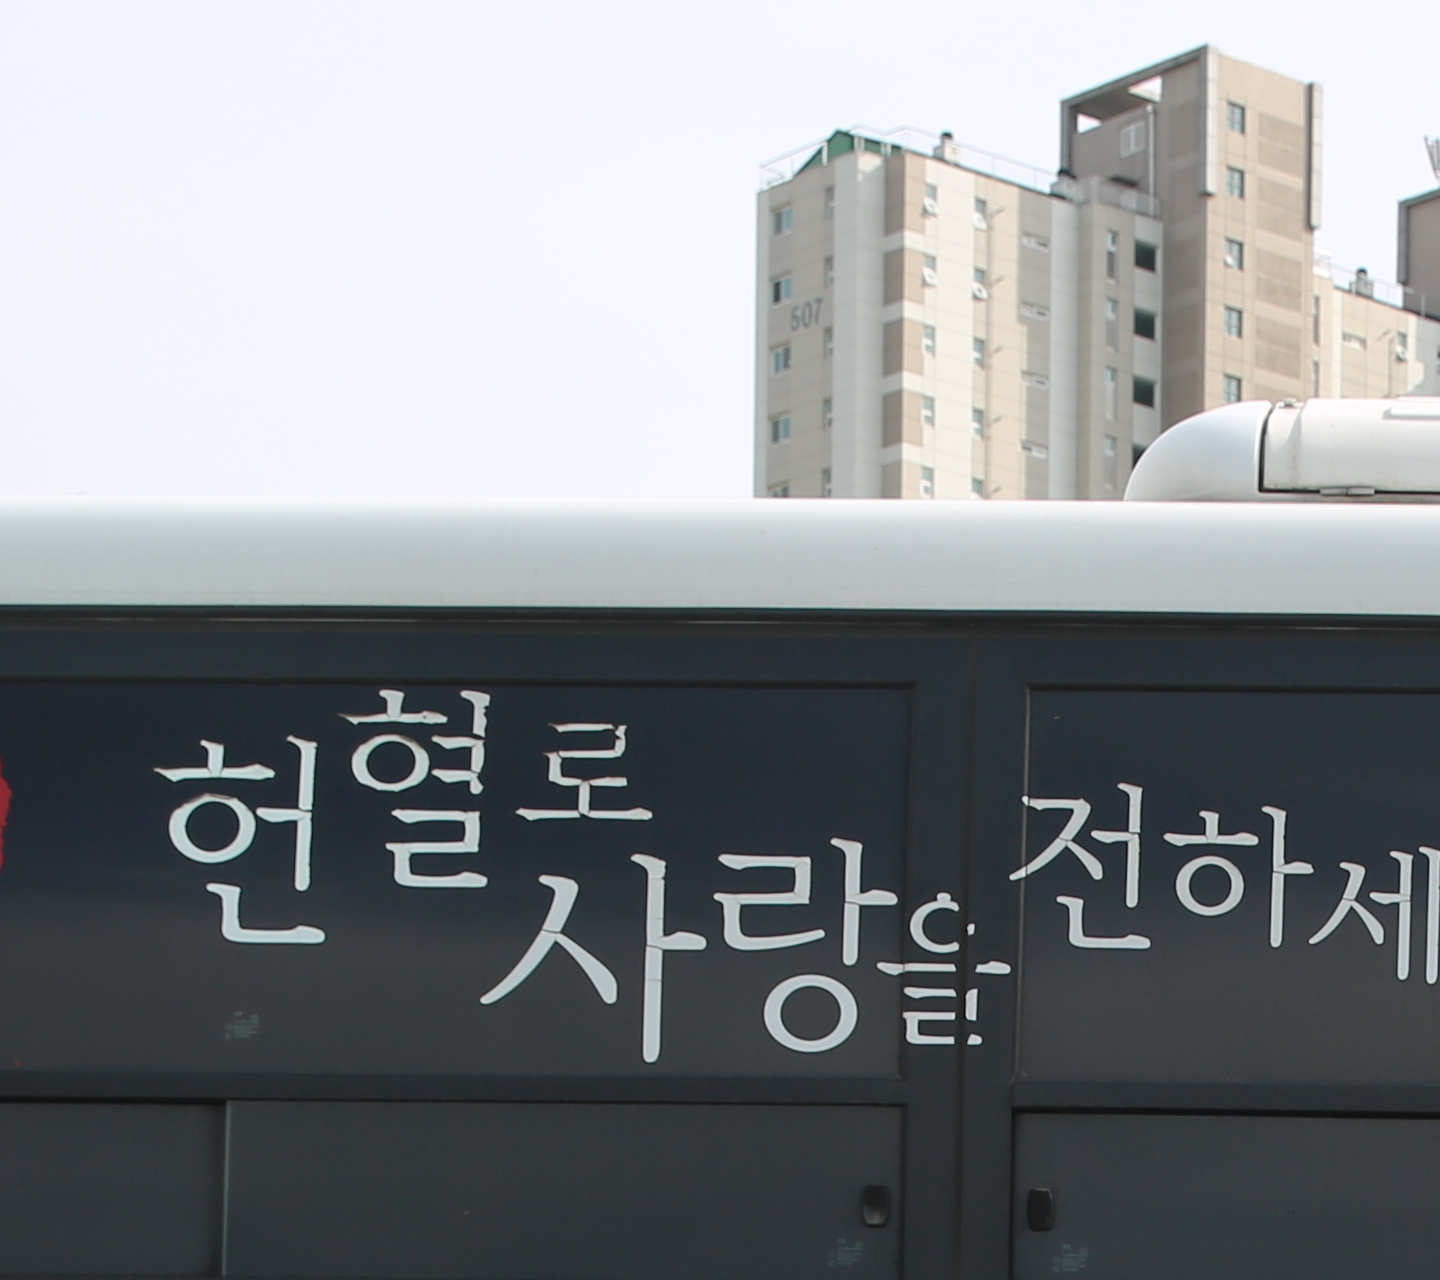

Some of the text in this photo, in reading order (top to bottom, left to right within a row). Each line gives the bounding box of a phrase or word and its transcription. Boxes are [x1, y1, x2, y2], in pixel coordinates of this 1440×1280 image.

[791, 297, 823, 332] 507
[154, 688, 653, 946] 헌혈로
[480, 836, 1012, 1063] 사랑을
